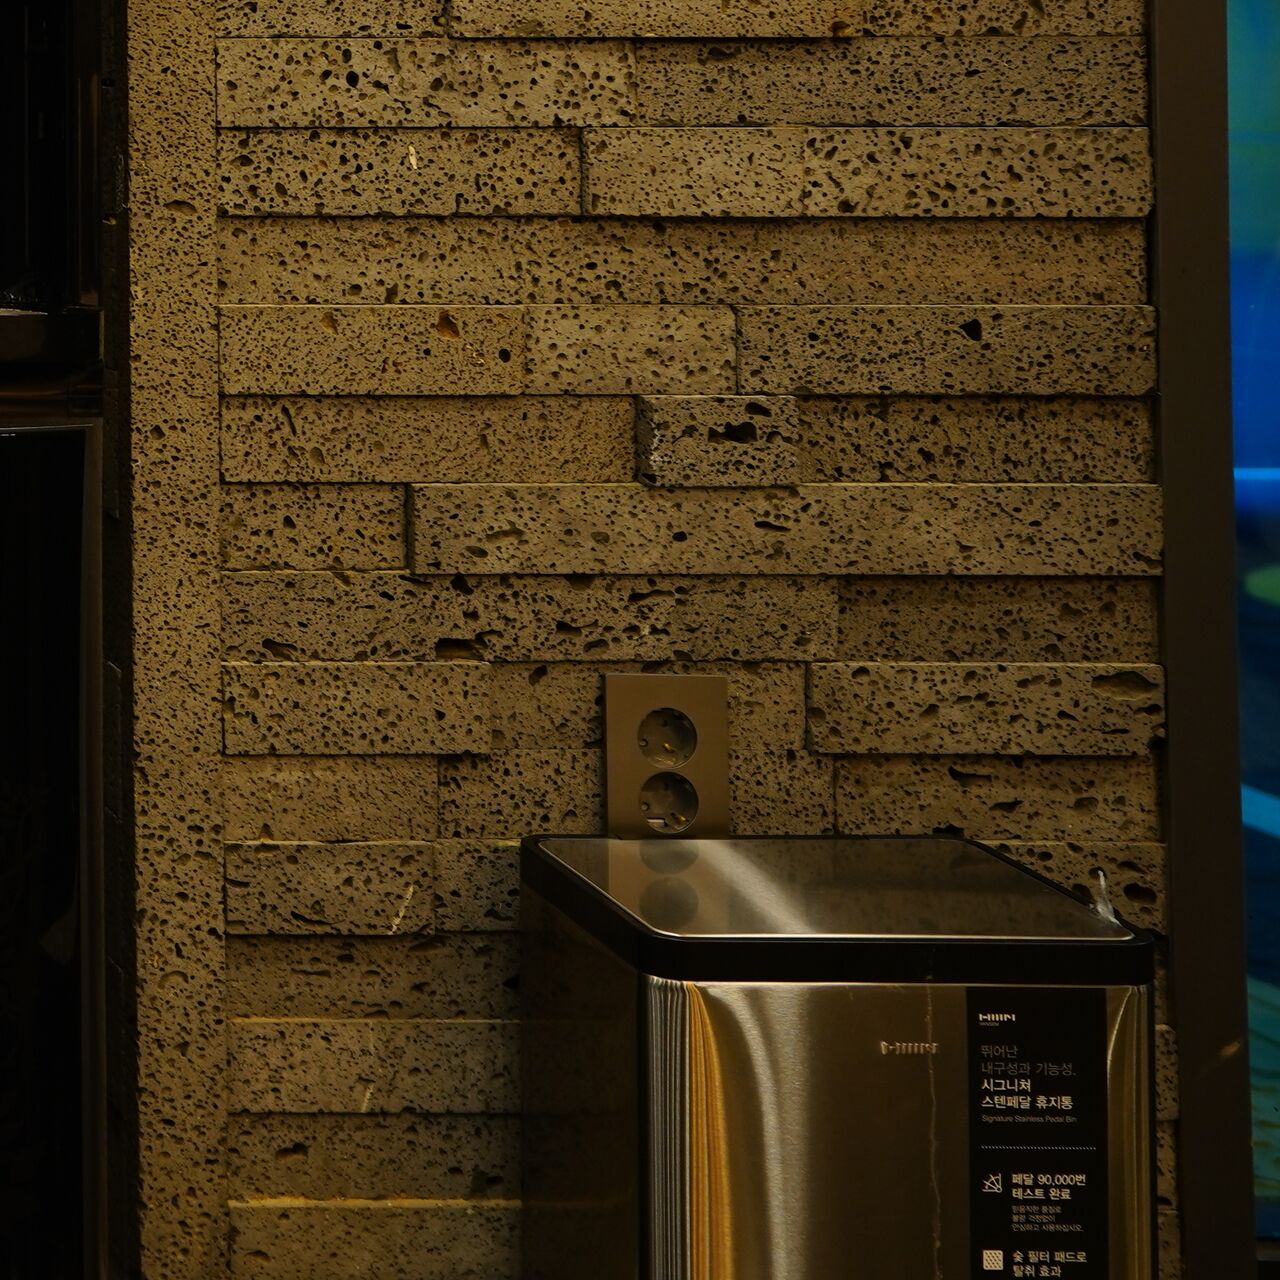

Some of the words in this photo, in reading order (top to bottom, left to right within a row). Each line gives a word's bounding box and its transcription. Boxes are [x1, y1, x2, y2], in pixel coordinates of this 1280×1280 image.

[981, 1045, 1018, 1058] 뛰어난
[981, 1062, 1031, 1075] 내구성과
[981, 1095, 1032, 1109] 스텐페달
[1035, 1095, 1073, 1110] 휴지통
[982, 1115, 1014, 1123] Signature
[1012, 1173, 1034, 1185] 페달
[1012, 1188, 1045, 1200] 테스트
[1049, 1188, 1072, 1200] 완료
[1028, 1250, 1050, 1263] 필터
[1054, 1251, 1087, 1263] 패드로
[1013, 1265, 1035, 1277] 탈취
[1039, 1265, 1062, 1277] 효과
